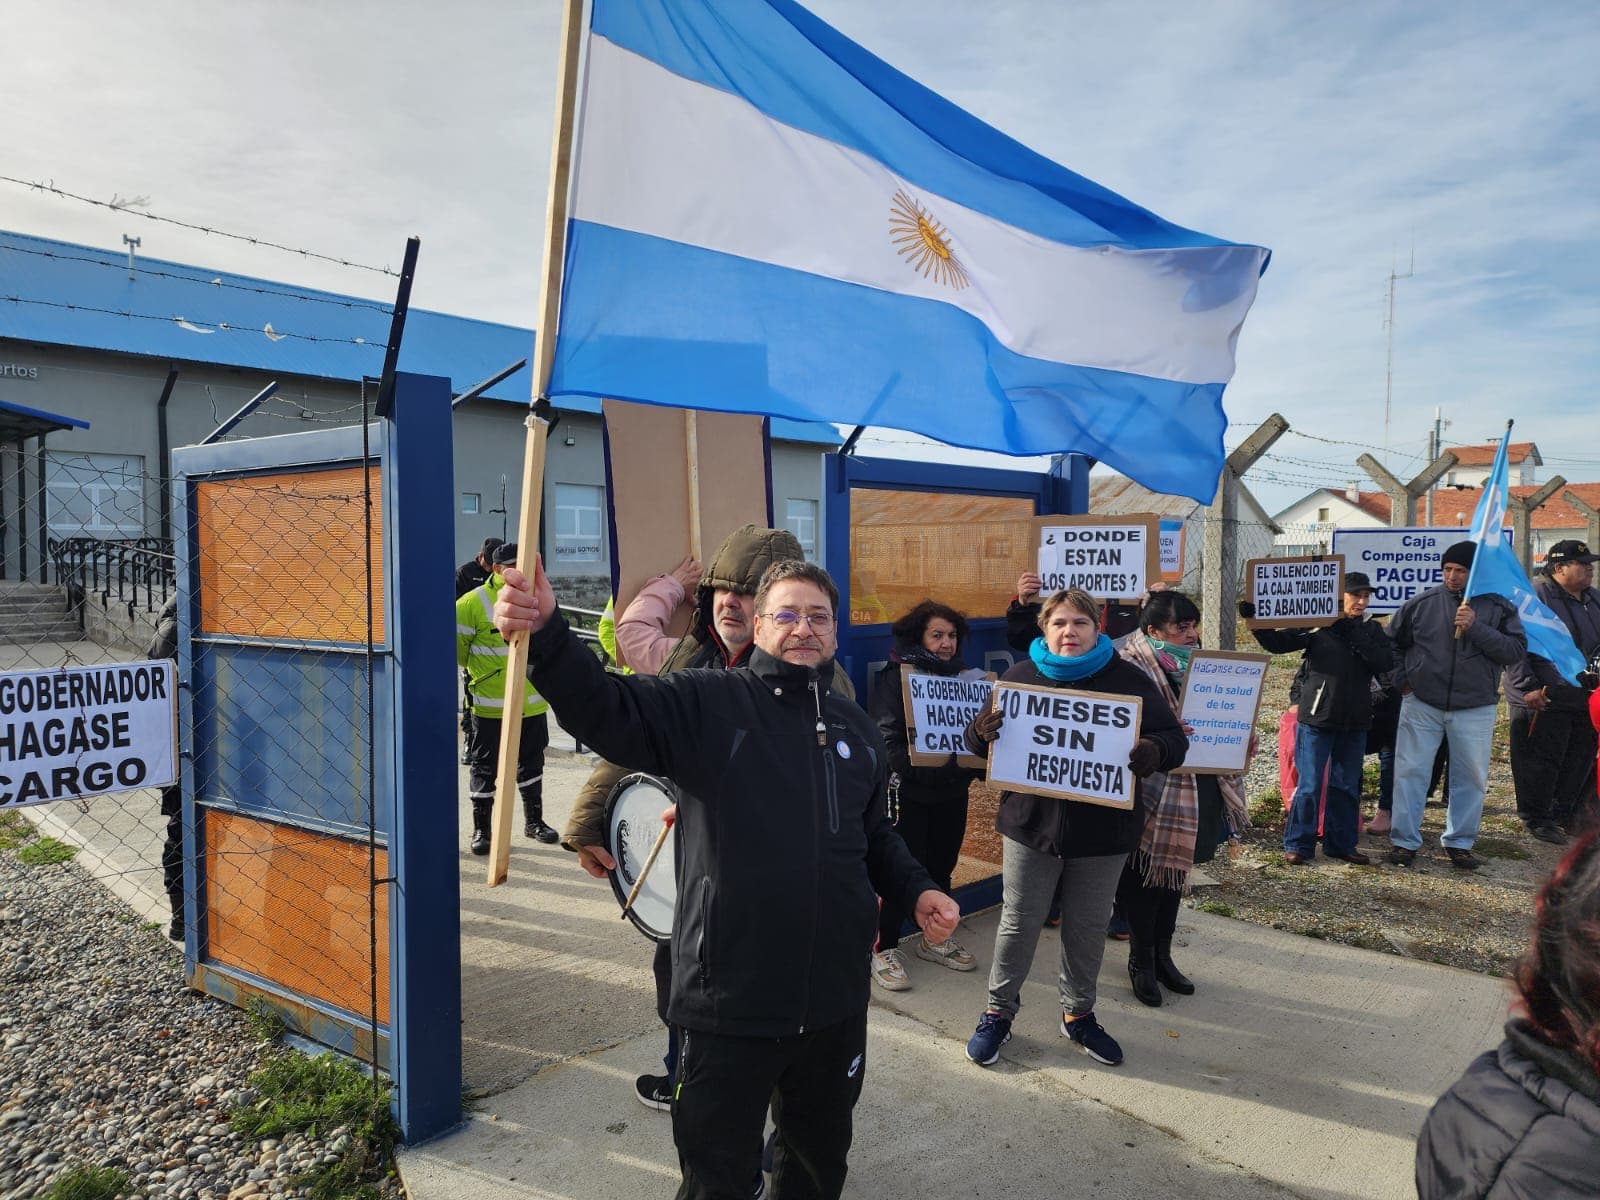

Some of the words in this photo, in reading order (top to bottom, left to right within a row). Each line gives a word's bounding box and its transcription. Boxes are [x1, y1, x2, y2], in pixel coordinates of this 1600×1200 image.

[1064, 531, 1141, 543] DONDE
[1160, 538, 1174, 546] UEN
[1402, 535, 1436, 550] Caja
[1065, 549, 1122, 566] ESTAN
[1361, 550, 1441, 564] Compensa
[1257, 567, 1269, 579] EL
[1272, 564, 1320, 578] SILENCIO
[1323, 564, 1337, 576] DE
[1042, 573, 1066, 591] LOS
[1069, 574, 1127, 592] APORTES
[1130, 575, 1138, 592] ?
[1257, 582, 1269, 596] LA
[1271, 581, 1293, 595] CAJA
[1296, 579, 1334, 594] TAMBIEN
[1258, 599, 1271, 617] ES
[1274, 597, 1334, 616] ABANDONO
[0, 666, 167, 715] GOBERNADOR
[911, 678, 925, 699] Sr.
[1193, 683, 1212, 694] Con
[1214, 684, 1223, 694] la
[1225, 685, 1253, 696] salud
[1000, 689, 1021, 720] 10
[1026, 694, 1132, 729] MESES
[1206, 699, 1219, 709] de
[1221, 700, 1236, 710] los
[0, 711, 131, 762] HAGASE
[924, 732, 965, 752] CAR
[1032, 724, 1096, 753] SIN
[1202, 735, 1213, 743] se
[1026, 752, 1124, 795] RESPUESTA
